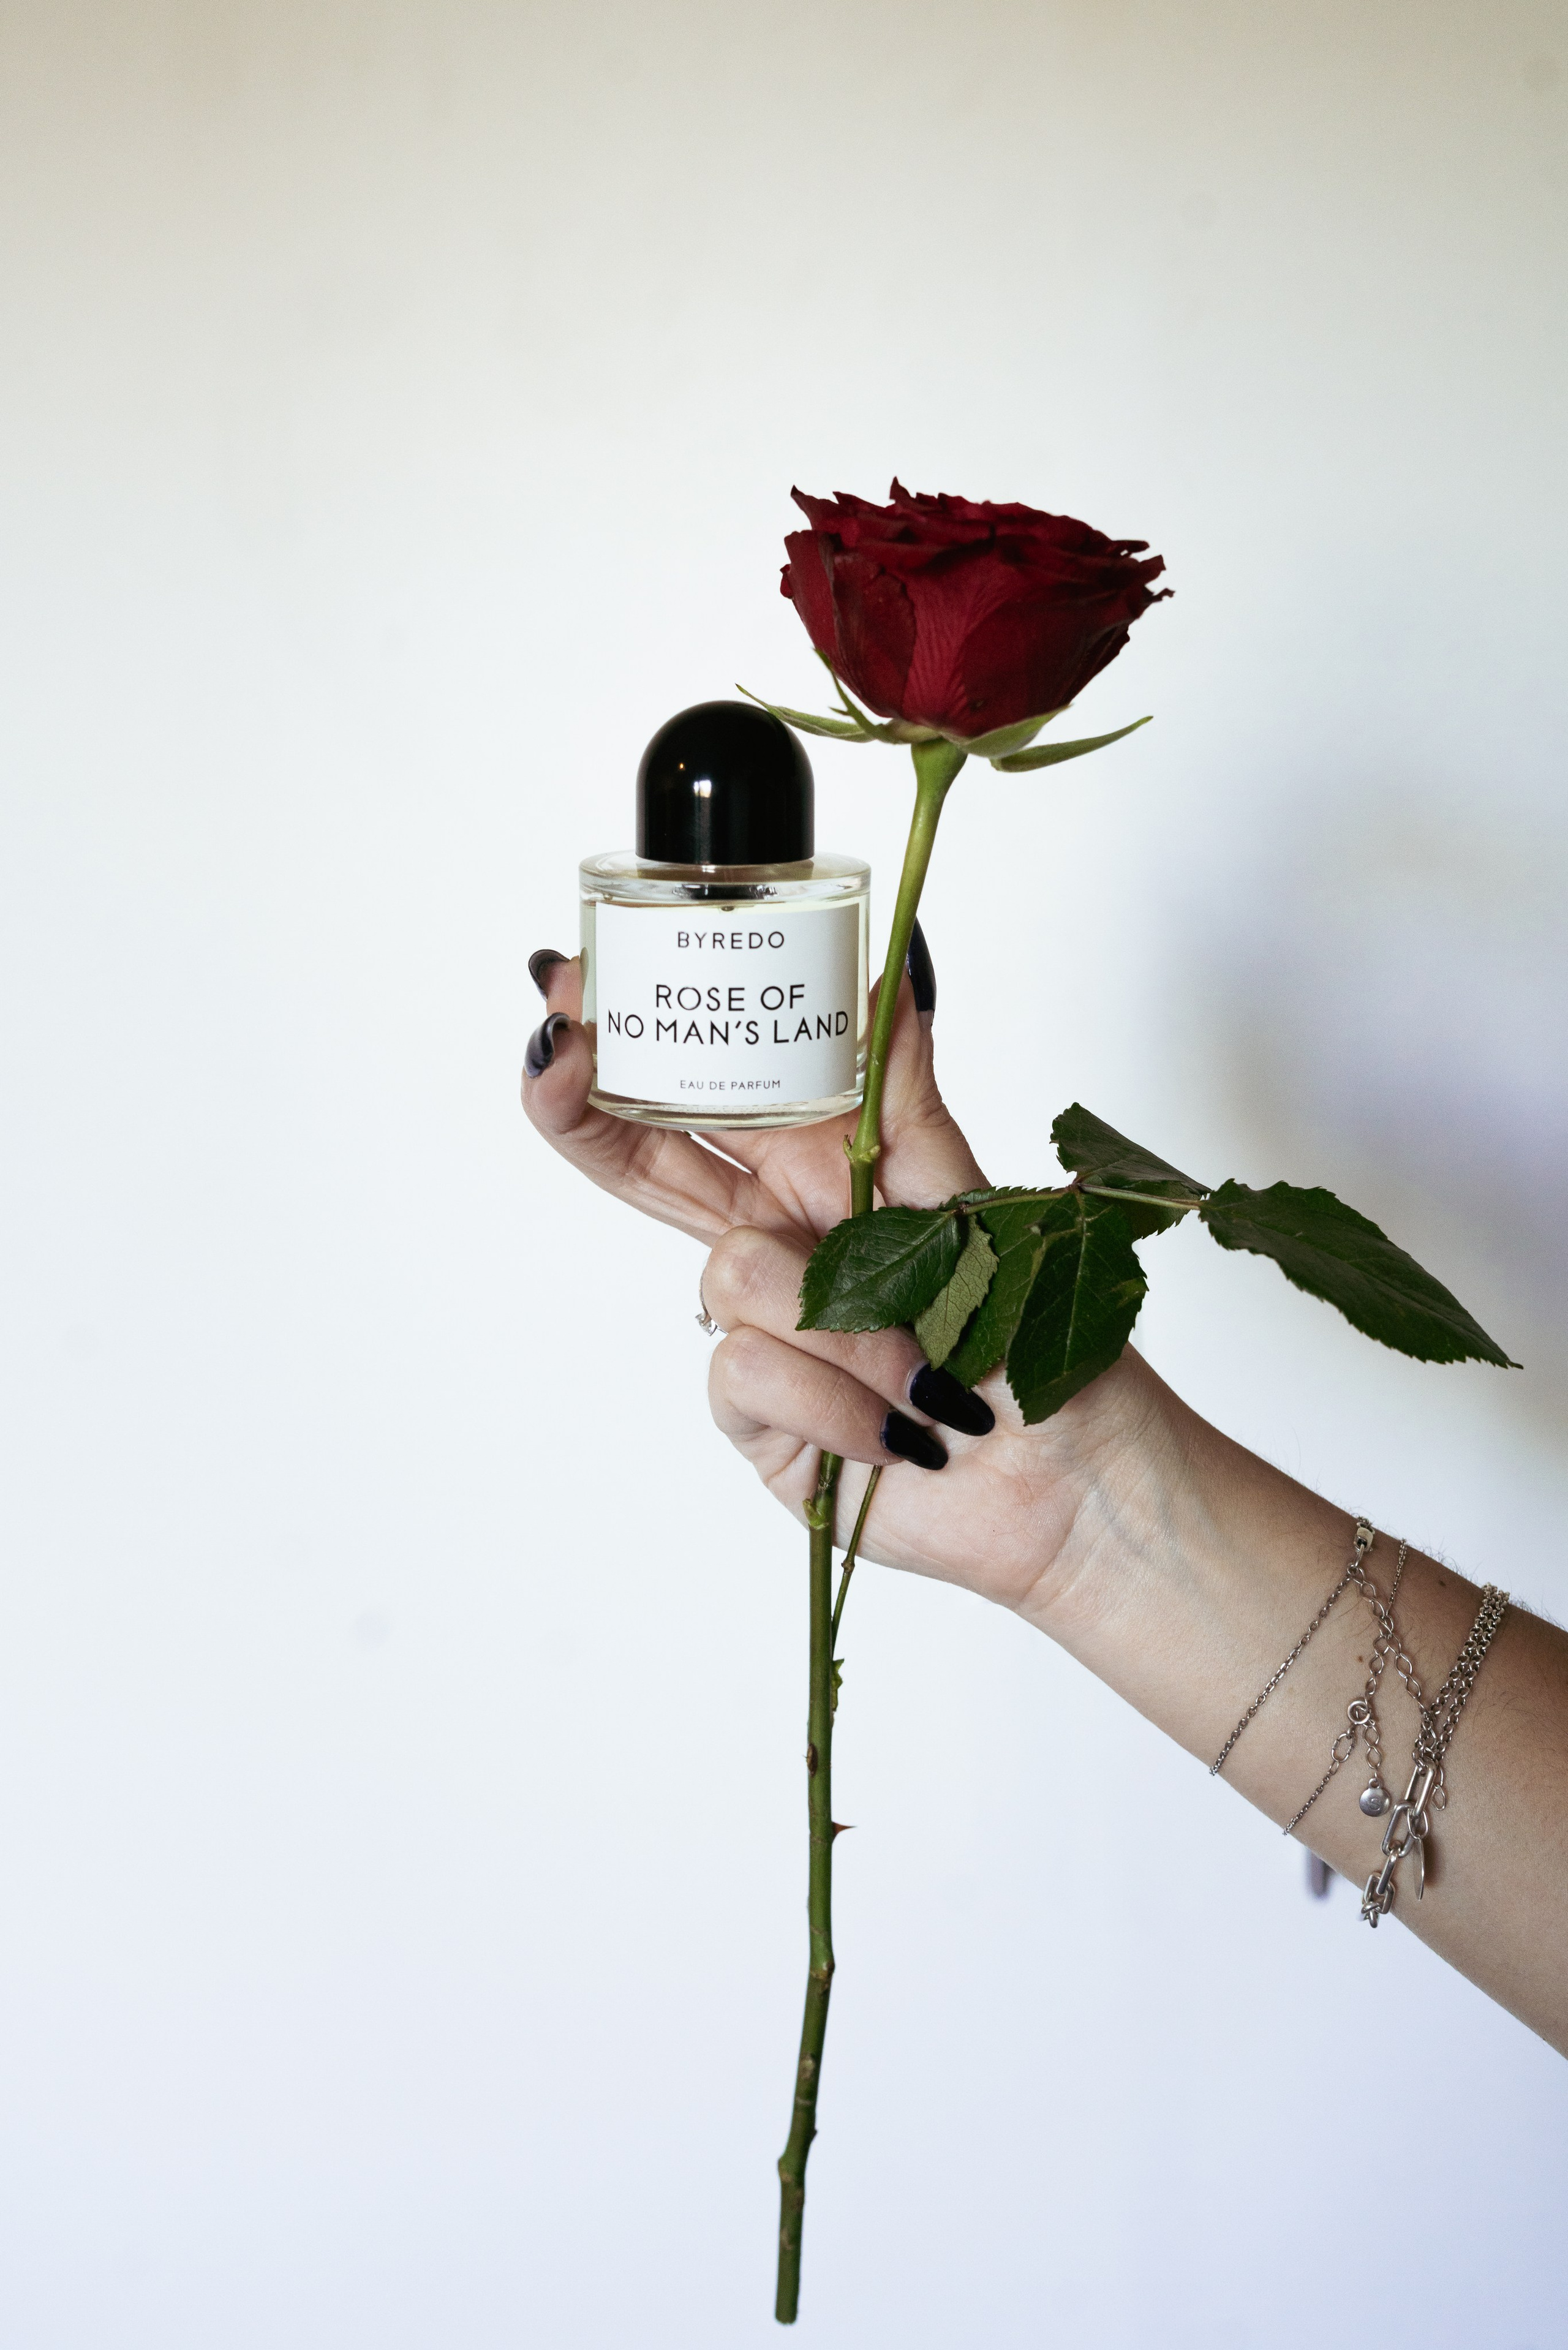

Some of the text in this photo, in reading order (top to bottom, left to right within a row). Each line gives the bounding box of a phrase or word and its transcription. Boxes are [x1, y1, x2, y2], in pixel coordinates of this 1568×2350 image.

[677, 931, 785, 949] BYREDO
[655, 984, 805, 1012] ROSE OF
[608, 1009, 848, 1046] NO MAN'S LAND
[680, 1079, 781, 1090] EAU DE PARFUM
